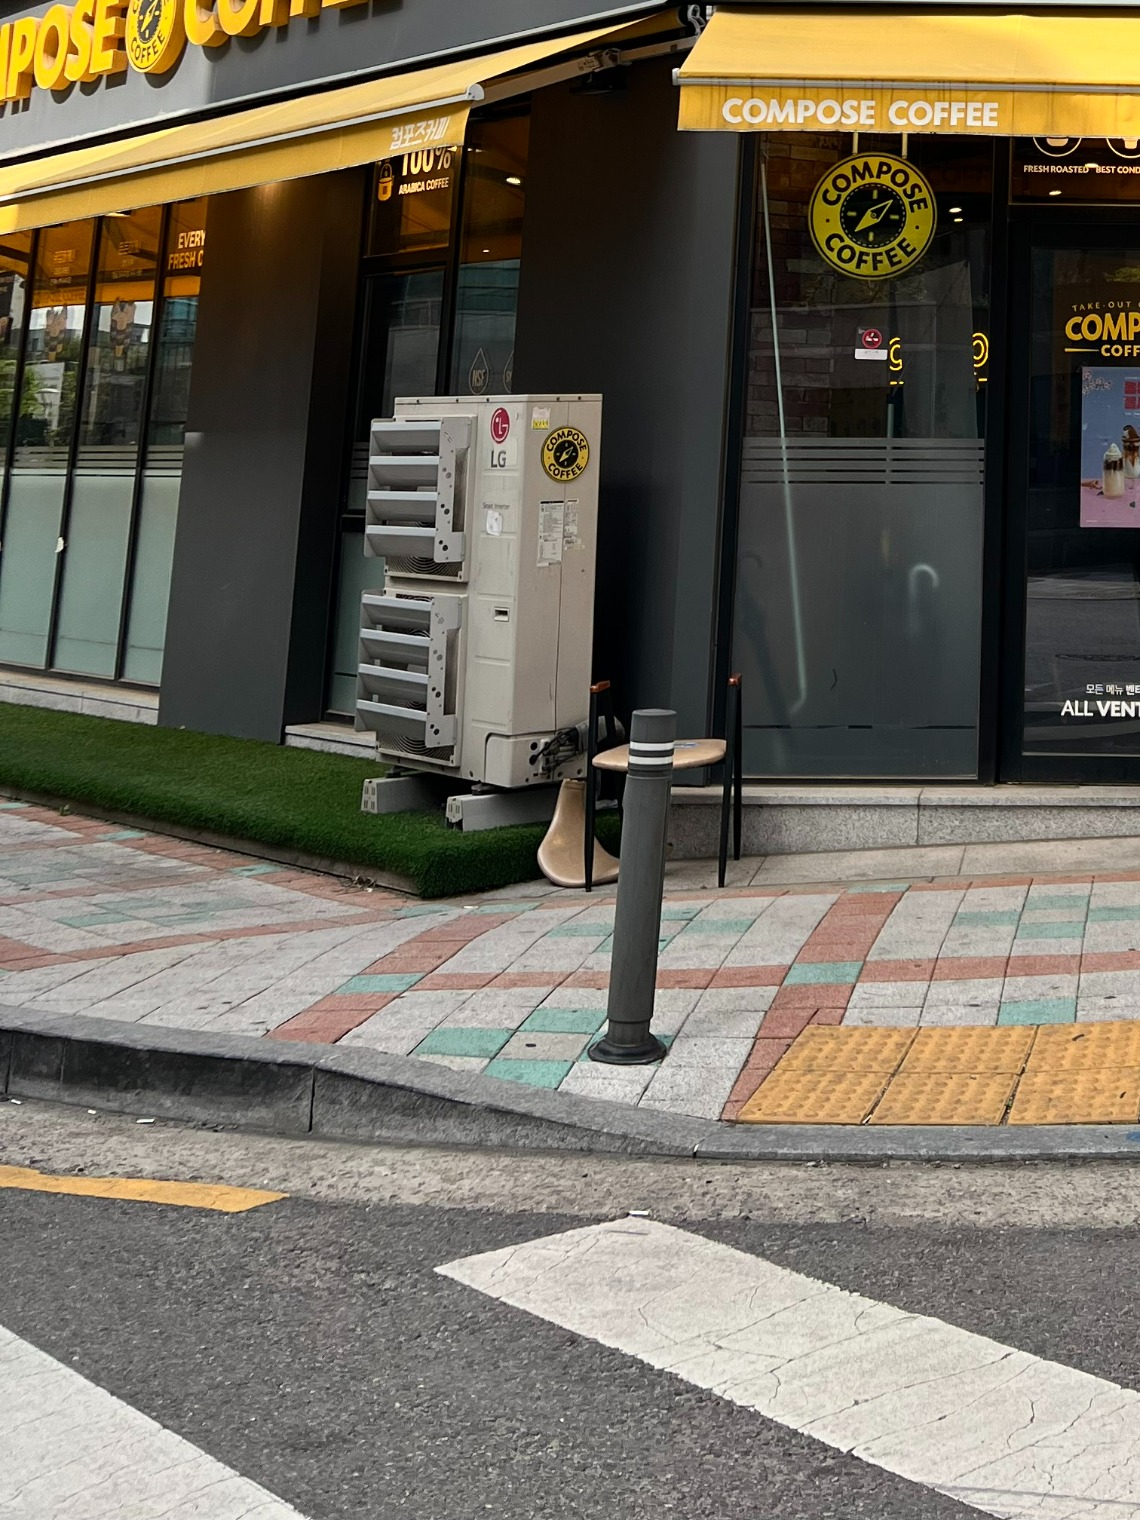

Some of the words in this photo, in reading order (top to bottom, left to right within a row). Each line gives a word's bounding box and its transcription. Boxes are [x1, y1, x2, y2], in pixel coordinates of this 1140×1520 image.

[132, 33, 167, 64] COFFEE
[721, 97, 876, 125] COMPOSE
[888, 101, 999, 127] COFFEE
[389, 115, 452, 151] 컴포즈커피
[1095, 165, 1116, 175] BEST
[398, 181, 425, 196] ARABICA
[425, 177, 450, 191] COFFEE
[822, 161, 928, 213] COMPOSE
[178, 230, 206, 250] EVERY
[168, 252, 196, 270] FRESH
[825, 233, 918, 272] COFFEE
[1072, 301, 1131, 313] TAKE-OUT
[546, 430, 587, 452] COMPOSE
[491, 450, 507, 468] LG
[548, 463, 584, 479] COFFEE
[1086, 684, 1103, 696] 모든
[1106, 684, 1123, 696] 메뉴
[1060, 700, 1094, 717] ALL
